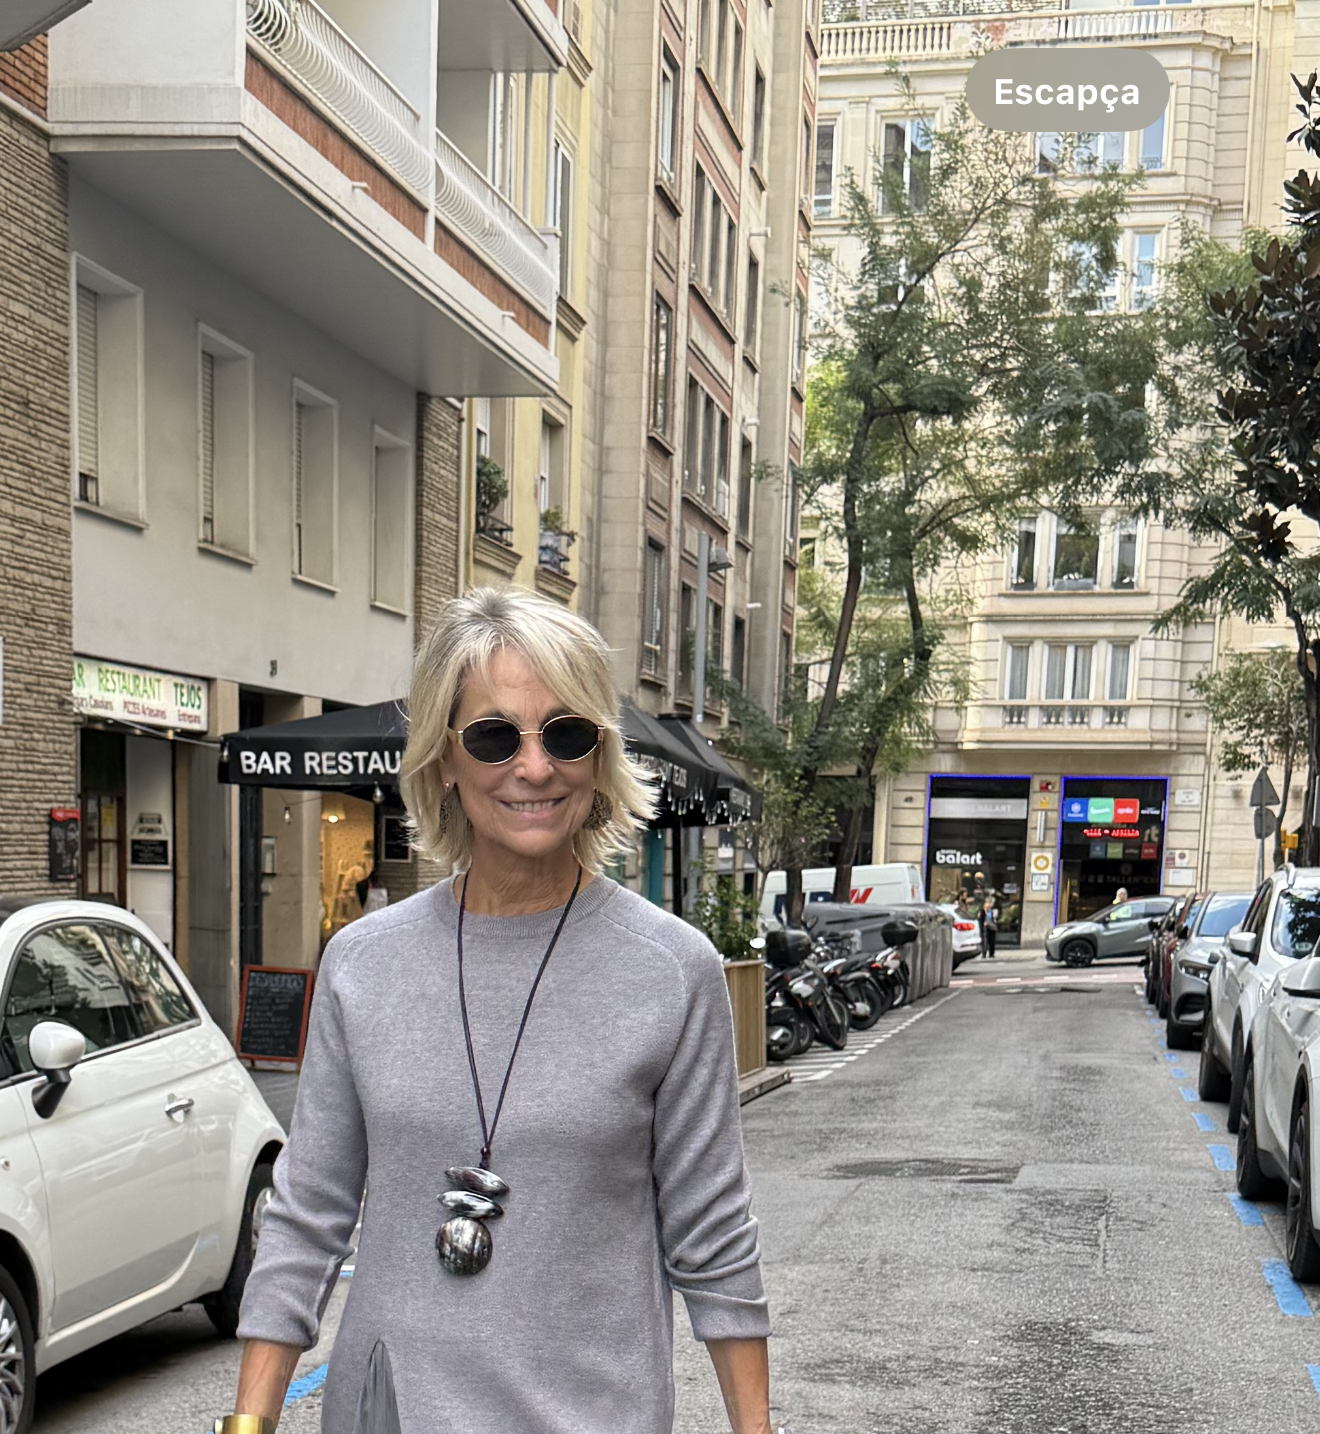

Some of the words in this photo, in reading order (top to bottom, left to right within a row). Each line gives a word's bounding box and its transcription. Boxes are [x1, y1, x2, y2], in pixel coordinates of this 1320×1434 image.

[97, 667, 160, 701] RESTAURANT
[173, 681, 202, 709] TEJOS
[240, 751, 292, 775] BAR
[304, 751, 401, 775] RESTAU
[936, 850, 983, 865] balart
